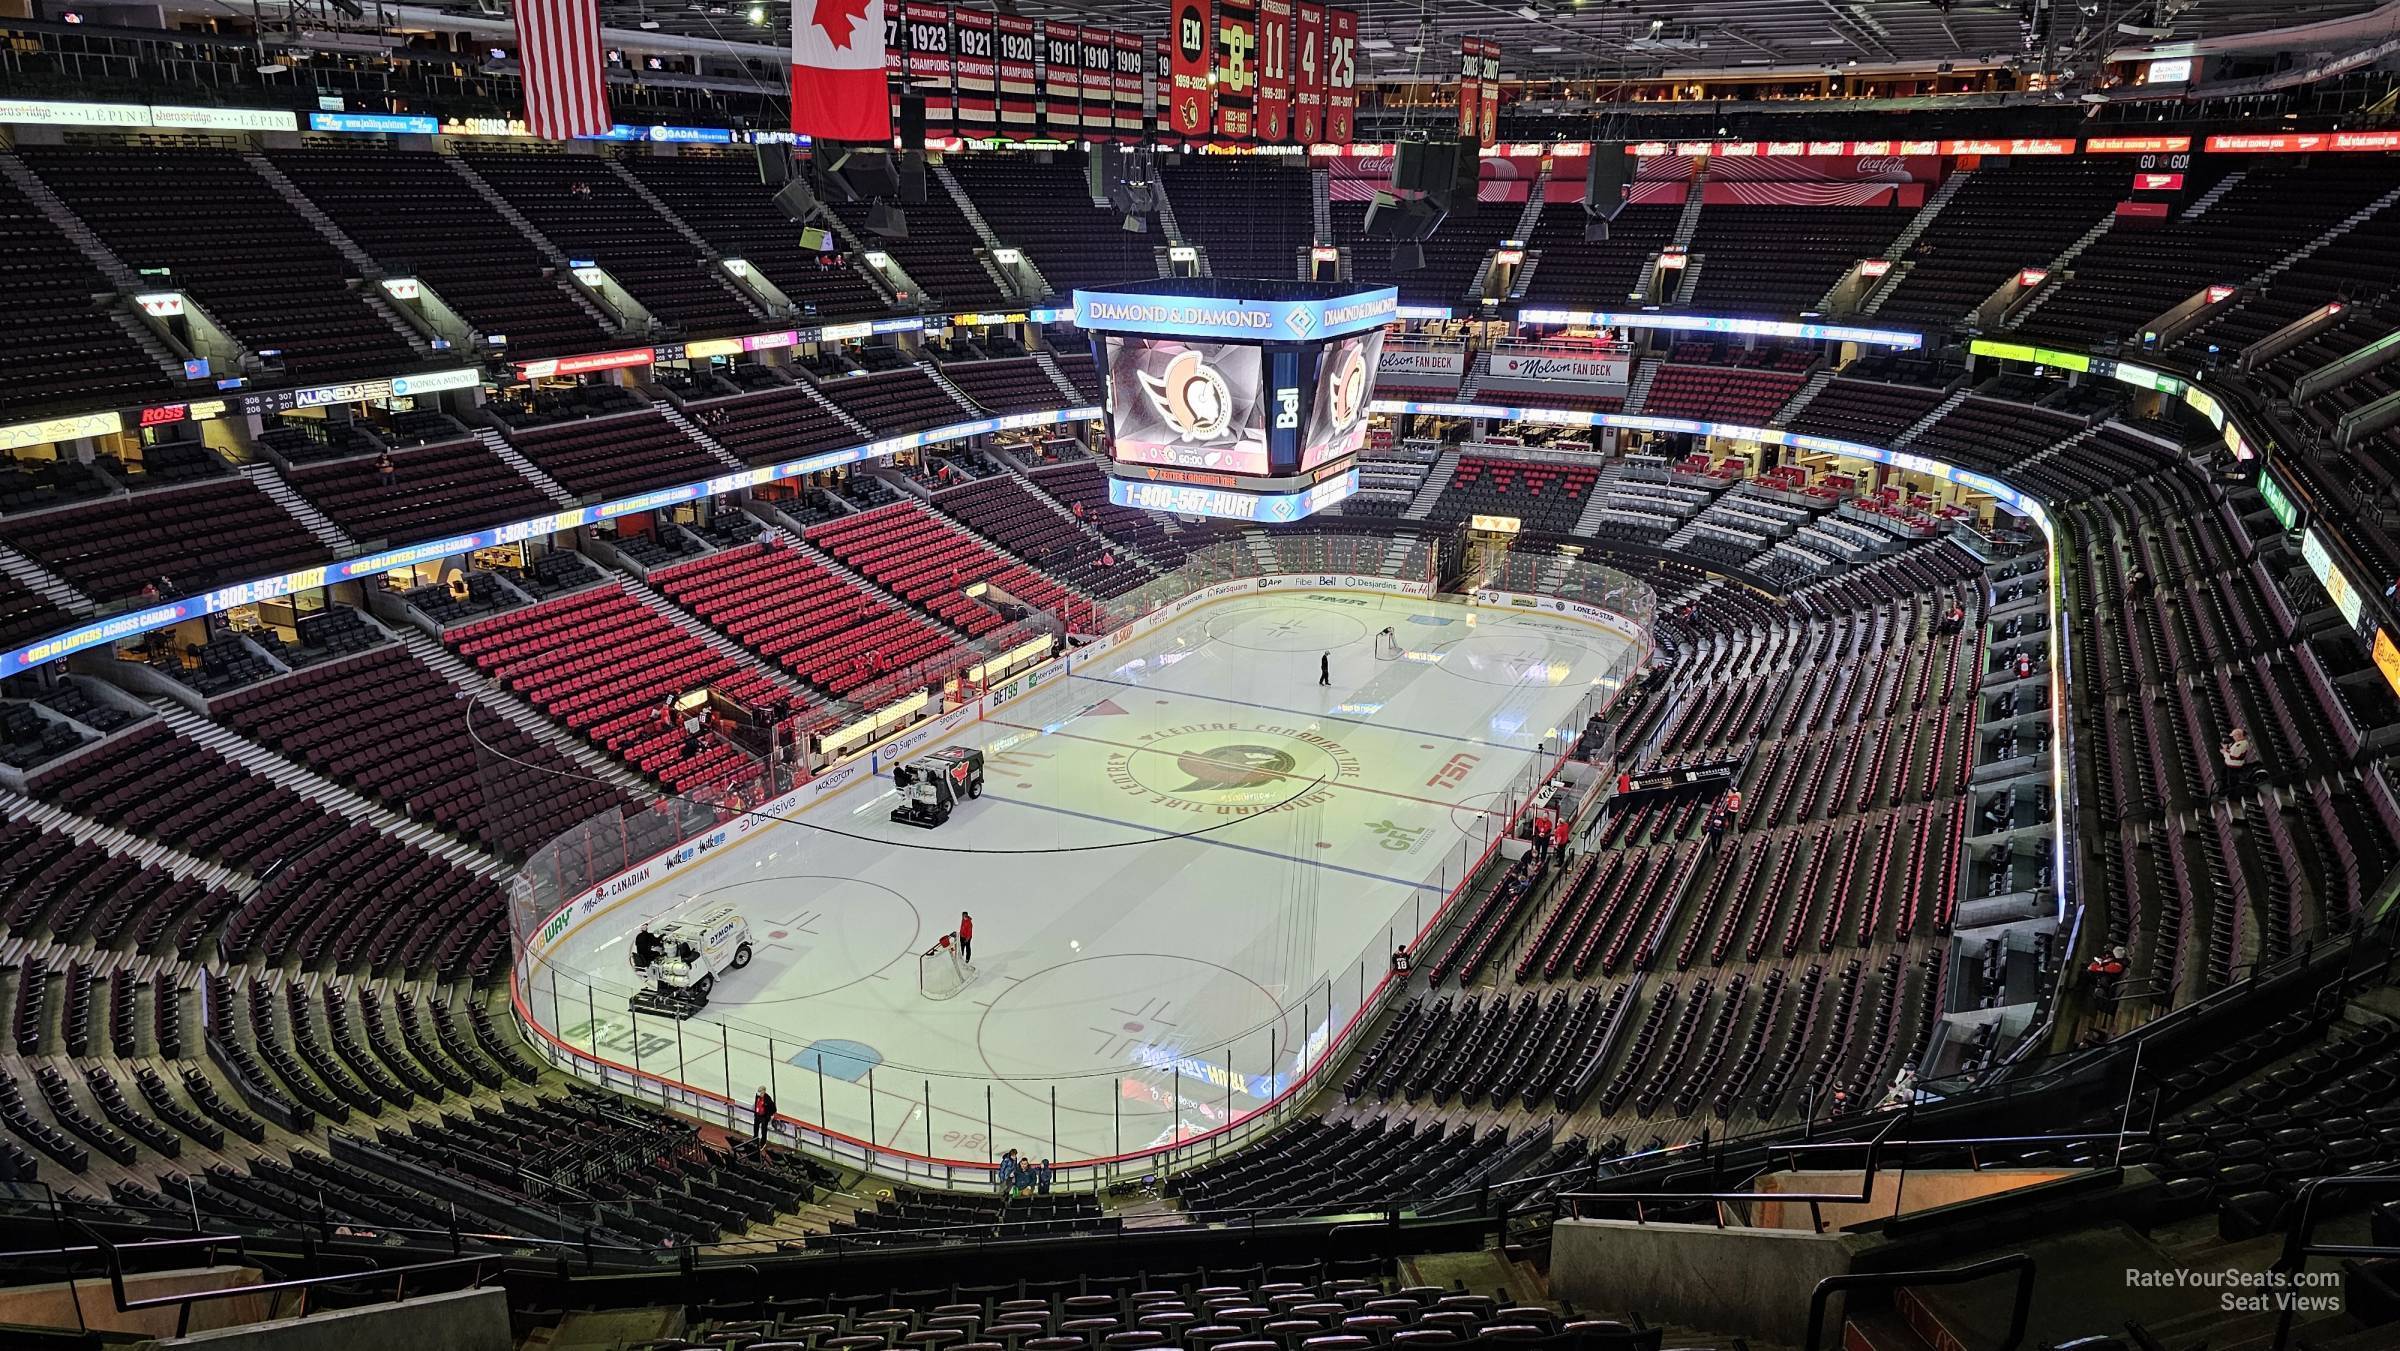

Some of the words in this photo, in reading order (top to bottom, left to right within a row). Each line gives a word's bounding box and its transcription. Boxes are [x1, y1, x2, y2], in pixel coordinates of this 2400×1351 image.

[1301, 9, 1321, 24] PHILLIPS
[910, 23, 947, 52] 1923
[959, 28, 991, 56] 1921
[1182, 18, 1201, 51] EM
[1001, 34, 1033, 61] 1920
[1048, 40, 1075, 65] 1911
[1083, 45, 1109, 69] 1910
[1230, 24, 1245, 92] 8
[1265, 22, 1283, 79] 11
[910, 57, 950, 72] CHAMPIONS
[957, 60, 994, 76] CHAMPIONS
[1116, 50, 1141, 73] 1909
[1158, 56, 1169, 76] 19
[1302, 32, 1315, 86] 4
[1331, 36, 1354, 89] 25
[1462, 55, 1478, 76] 2003
[1483, 58, 1499, 80] 2007
[1002, 65, 1034, 79] CHAMPIONS
[1047, 70, 1077, 83] CHAMPIONS
[1083, 73, 1110, 86] CHAMPIONS
[1115, 77, 1141, 90] CHAMPIONS
[1256, 145, 1303, 155] HARDWARE
[2106, 141, 2122, 149] what
[2145, 141, 2161, 150] you
[2140, 155, 2155, 169] GO
[2170, 155, 2190, 169] GO!
[1089, 303, 1167, 323] DIAMOND
[1169, 308, 1183, 323] &
[1184, 307, 1266, 328] DIAMOND
[1324, 307, 1358, 327] DIAMOND
[1416, 356, 1430, 368] FAN
[1432, 357, 1452, 369] DECK
[1520, 359, 1571, 378] Molson
[1573, 363, 1588, 375] FAN
[1591, 364, 1611, 376] DECK
[410, 379, 442, 388] KONICA
[444, 374, 477, 385] MINOLTA
[143, 407, 184, 422] ROSS
[1276, 387, 1299, 429] Bell
[1178, 454, 1203, 466] 60:00
[1125, 484, 1258, 518] 1-800-567-HURT
[383, 550, 416, 568] LAWYERS
[417, 544, 445, 558] ACROSS
[204, 566, 327, 614] 1-800-567-HURT
[1216, 583, 1248, 595] FairSquare
[1295, 577, 1312, 586] Fibe
[1319, 576, 1336, 586] Bell
[1358, 579, 1397, 590] Desjardins
[1400, 582, 1418, 594] Tim
[214, 611, 227, 619] 104
[1573, 604, 1592, 615] LONE
[1599, 611, 1615, 622] STAR
[62, 629, 103, 652] LAWYERS
[103, 617, 140, 638] ACROSS
[140, 607, 177, 627] CANADA
[993, 682, 1018, 707] BET99
[940, 707, 969, 726] SPORTCHEK
[900, 730, 928, 751] Supreme
[1154, 722, 1239, 742] CENTRE
[1255, 723, 1350, 755] CANADIAN
[1342, 756, 1361, 779] TIRE
[815, 767, 855, 795] JACKPOTCITY
[1426, 752, 1481, 789] TSN
[750, 796, 797, 828] Decisive
[1152, 795, 1203, 814] TIRE
[1216, 791, 1336, 815] CANADIAN
[1380, 827, 1426, 851] GFL
[611, 867, 650, 896] CANADIAN
[532, 906, 573, 954] UBWAY
[710, 922, 734, 944] DYMON
